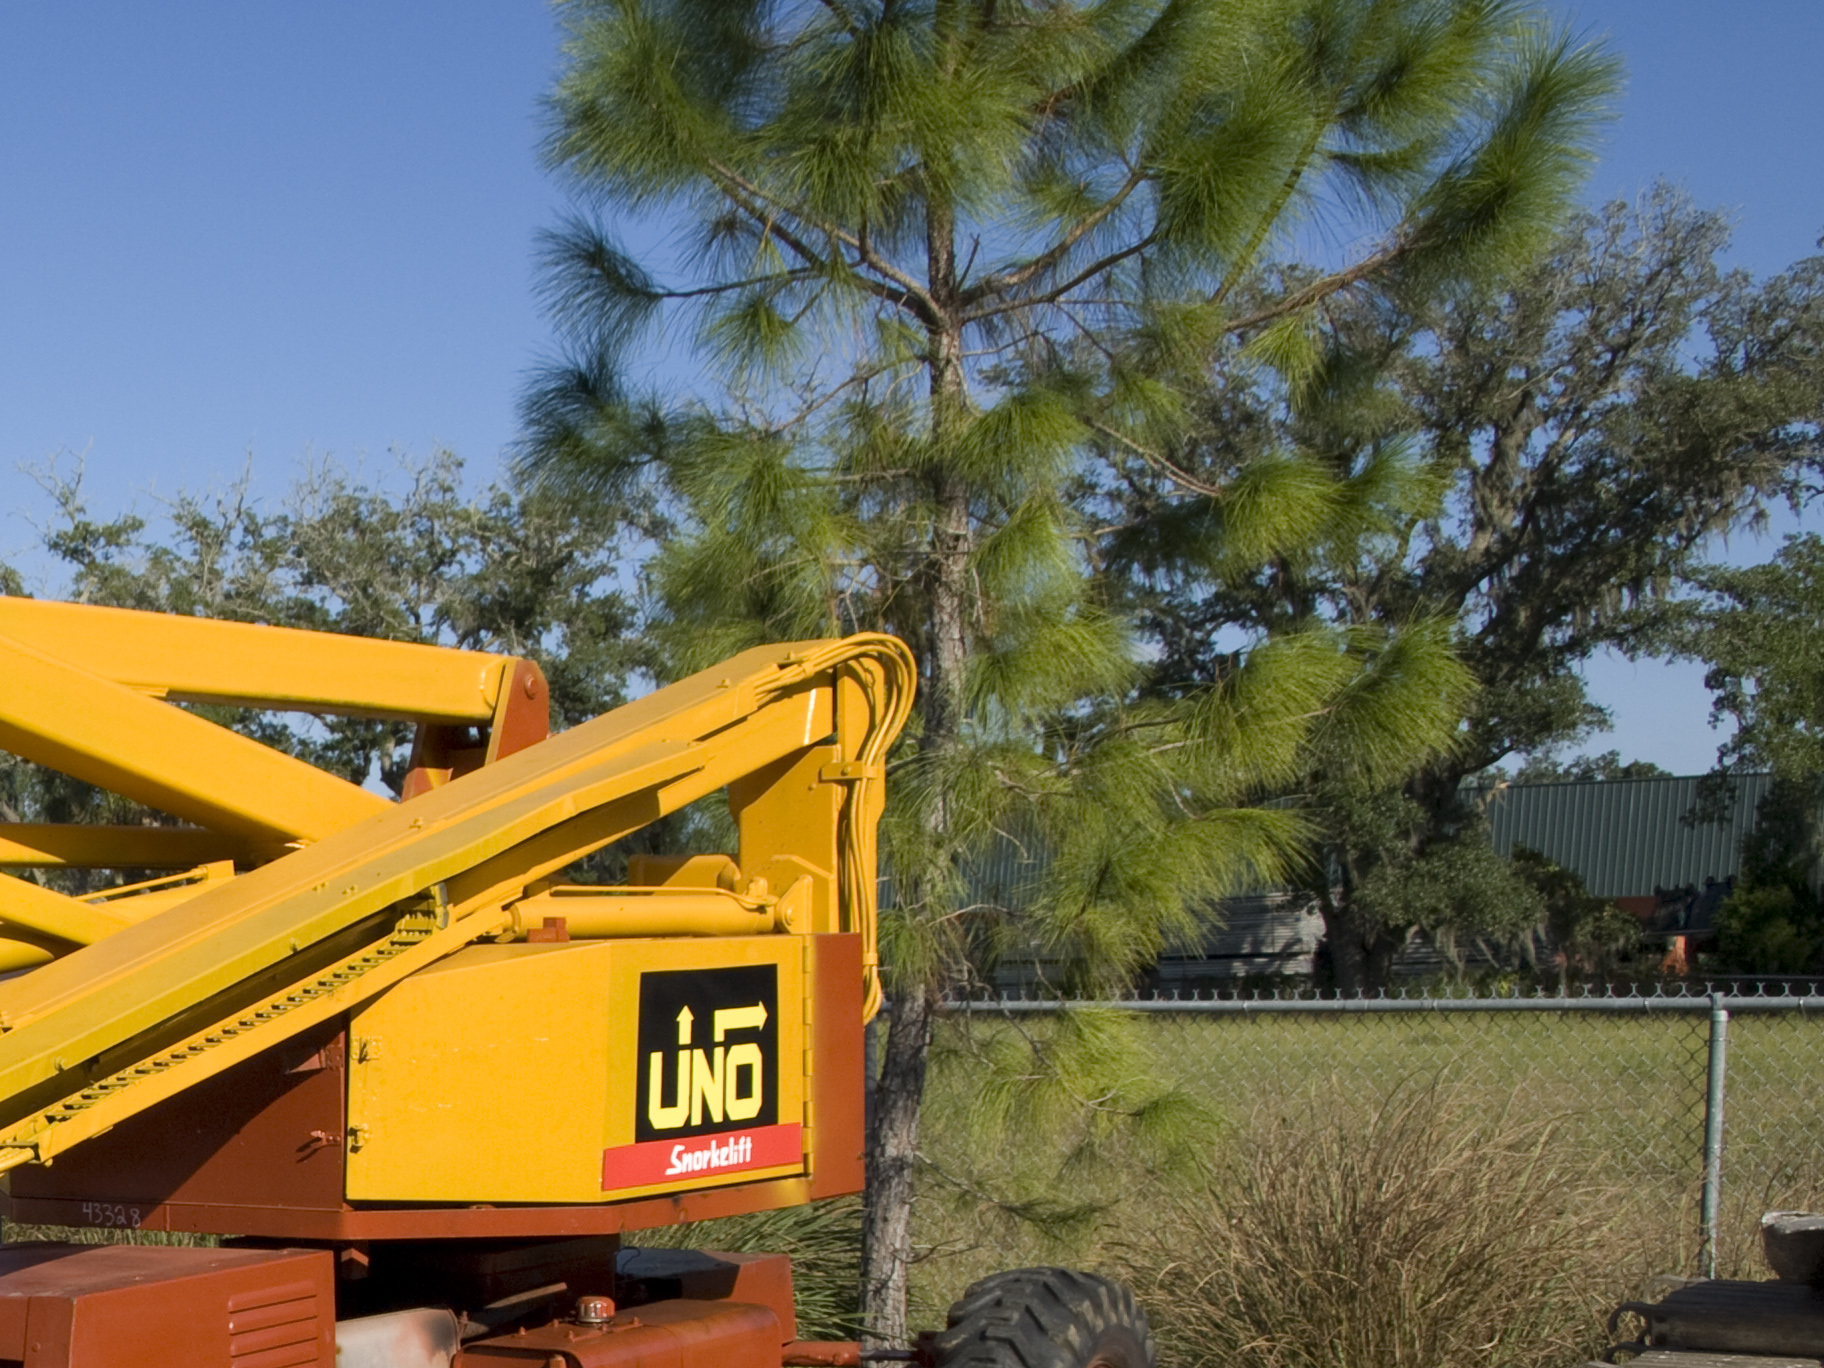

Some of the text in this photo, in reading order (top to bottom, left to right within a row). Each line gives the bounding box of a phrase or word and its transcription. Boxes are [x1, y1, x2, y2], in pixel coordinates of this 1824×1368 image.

[648, 1042, 762, 1129] UNO
[665, 1136, 752, 1175] Snorkelift
[82, 1203, 141, 1228] 43328
